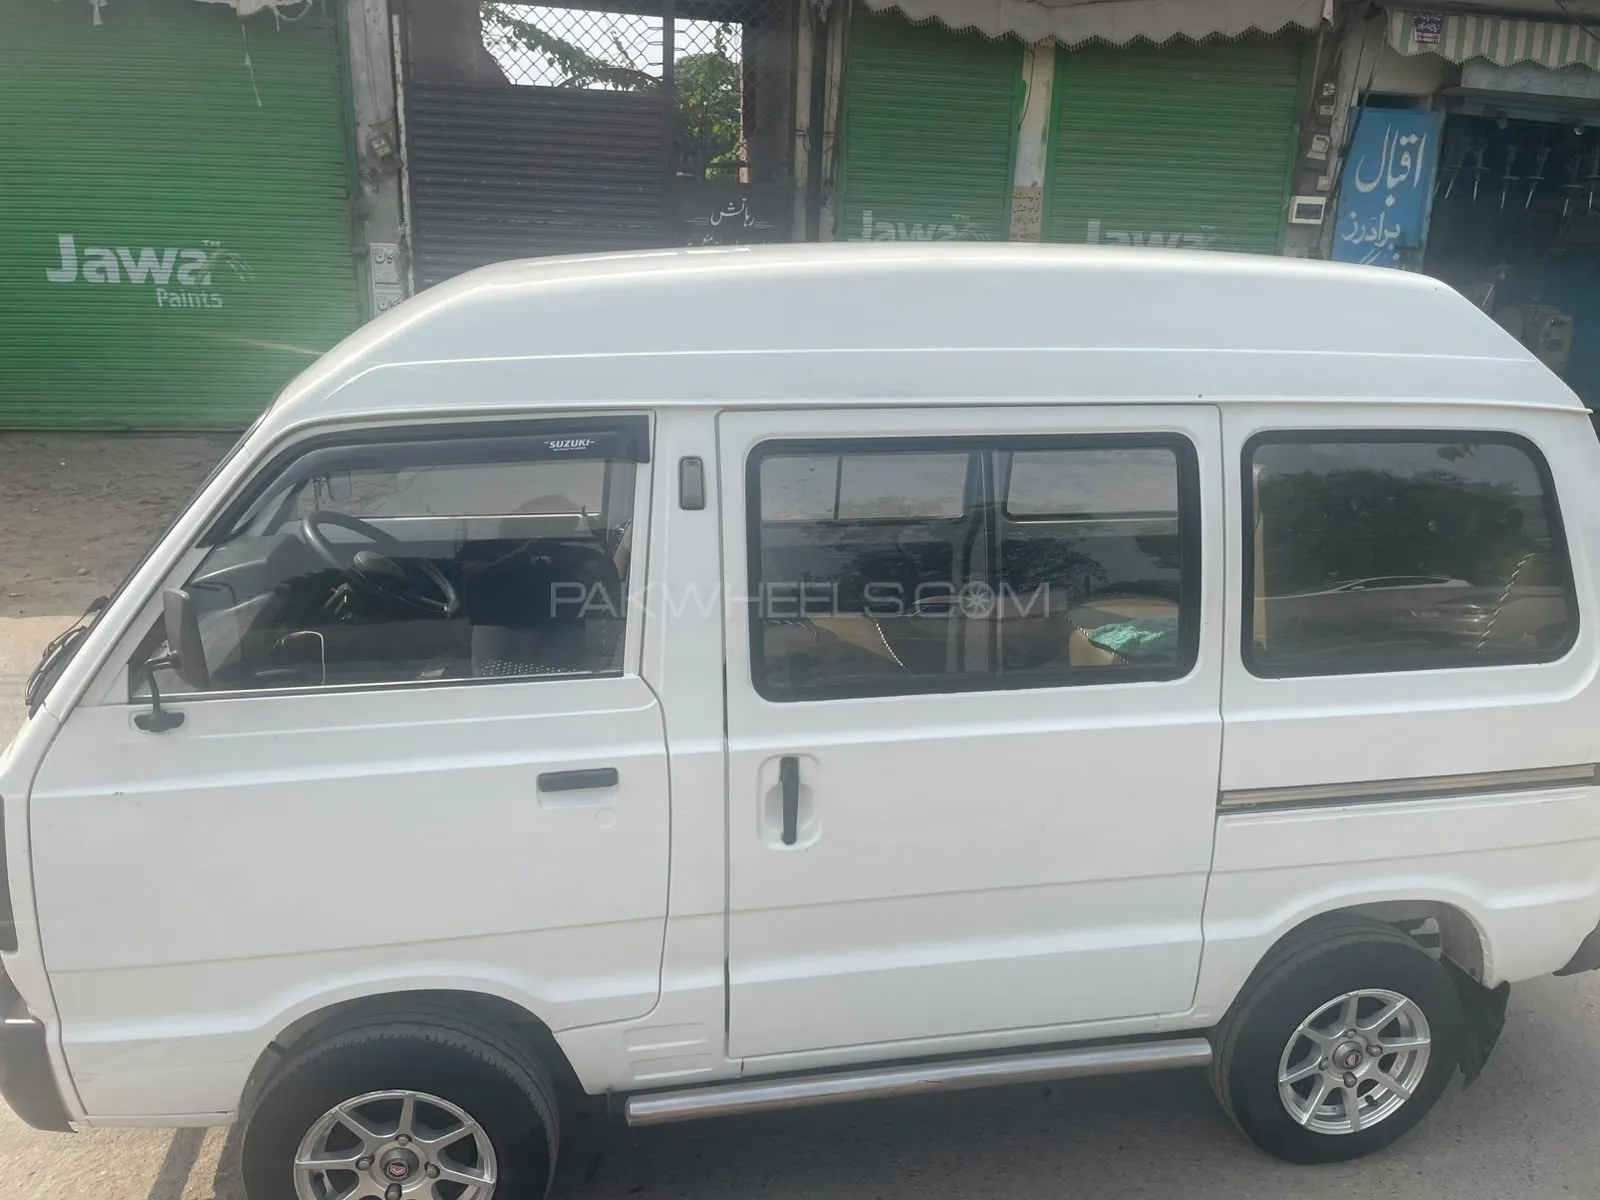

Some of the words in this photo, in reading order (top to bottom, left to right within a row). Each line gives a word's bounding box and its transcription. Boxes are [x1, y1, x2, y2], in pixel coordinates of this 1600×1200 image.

[1354, 123, 1428, 207] اقبال
[46, 233, 212, 285] Jawa
[156, 287, 223, 308] Paints
[548, 438, 591, 449] SUZUKI
